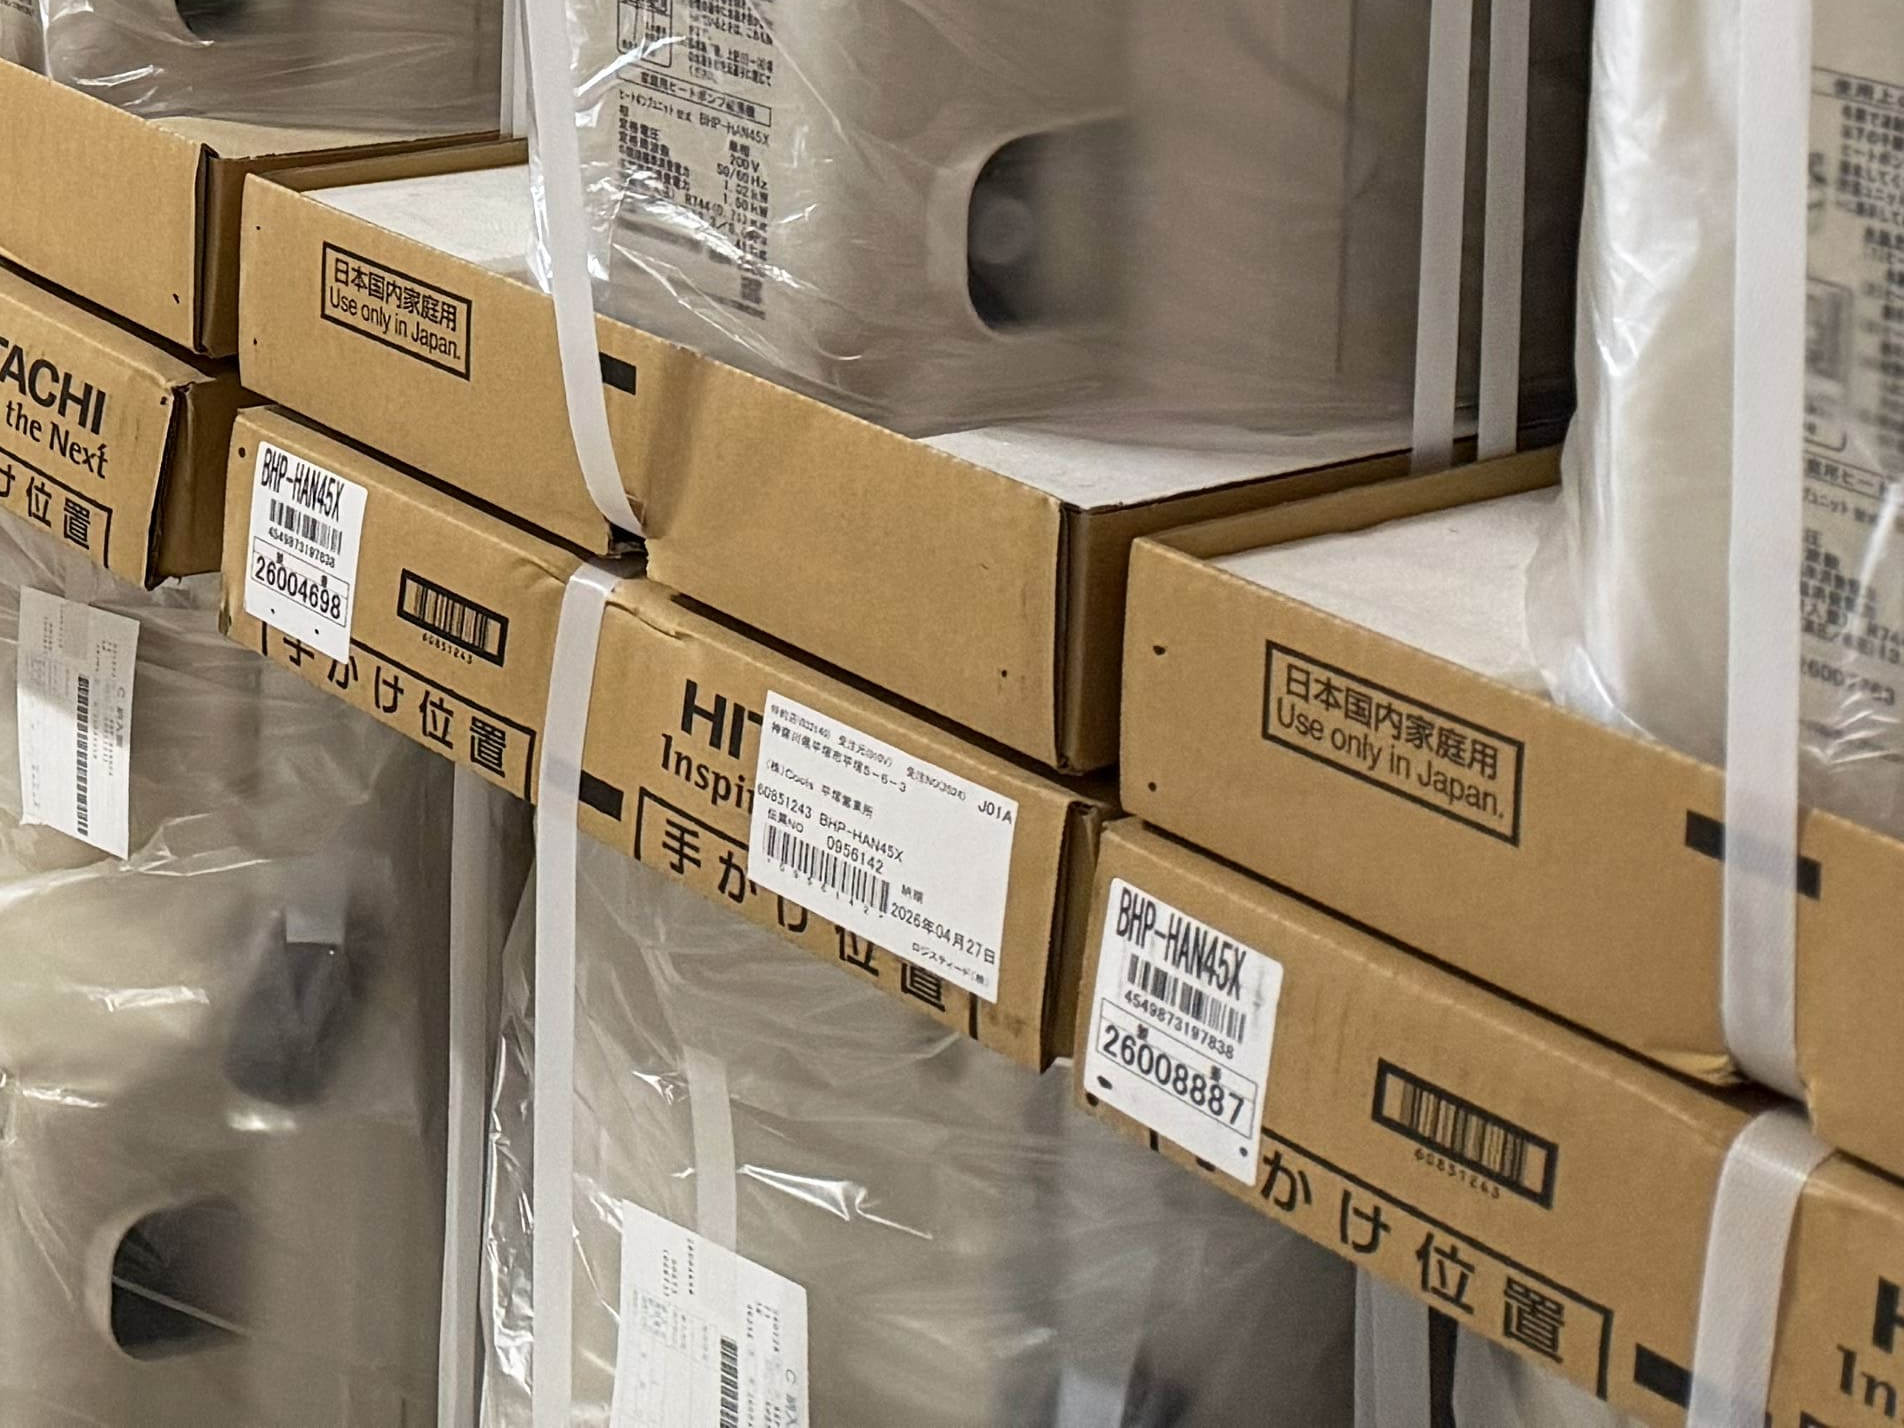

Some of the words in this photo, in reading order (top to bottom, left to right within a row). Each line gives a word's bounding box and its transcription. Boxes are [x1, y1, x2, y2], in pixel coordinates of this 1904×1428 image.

[329, 285, 357, 316] Use
[361, 304, 391, 335] only
[394, 312, 408, 339] in
[412, 322, 462, 362] Japan.
[333, 256, 458, 333] 日本国内家庭用
[6, 395, 45, 443] the
[49, 421, 110, 481] Next
[260, 447, 345, 523] BHP-HAN45X
[254, 555, 342, 620] 26004698
[1275, 695, 1324, 741] Use
[1330, 726, 1384, 777] only
[1391, 742, 1413, 781] in
[1416, 761, 1505, 821] Japan.
[1284, 663, 1499, 782] 日本国内家庭用
[756, 783, 813, 820] 60851243
[818, 812, 906, 864] BHP-HAN45X
[977, 799, 1013, 826] J01A
[825, 835, 885, 876] 0956142
[890, 901, 997, 966] 2026年04月27日
[1115, 886, 1247, 1001] BHP-HAN45X
[1124, 990, 1235, 1061] 4549873197838
[1103, 1024, 1245, 1126] 26008887
